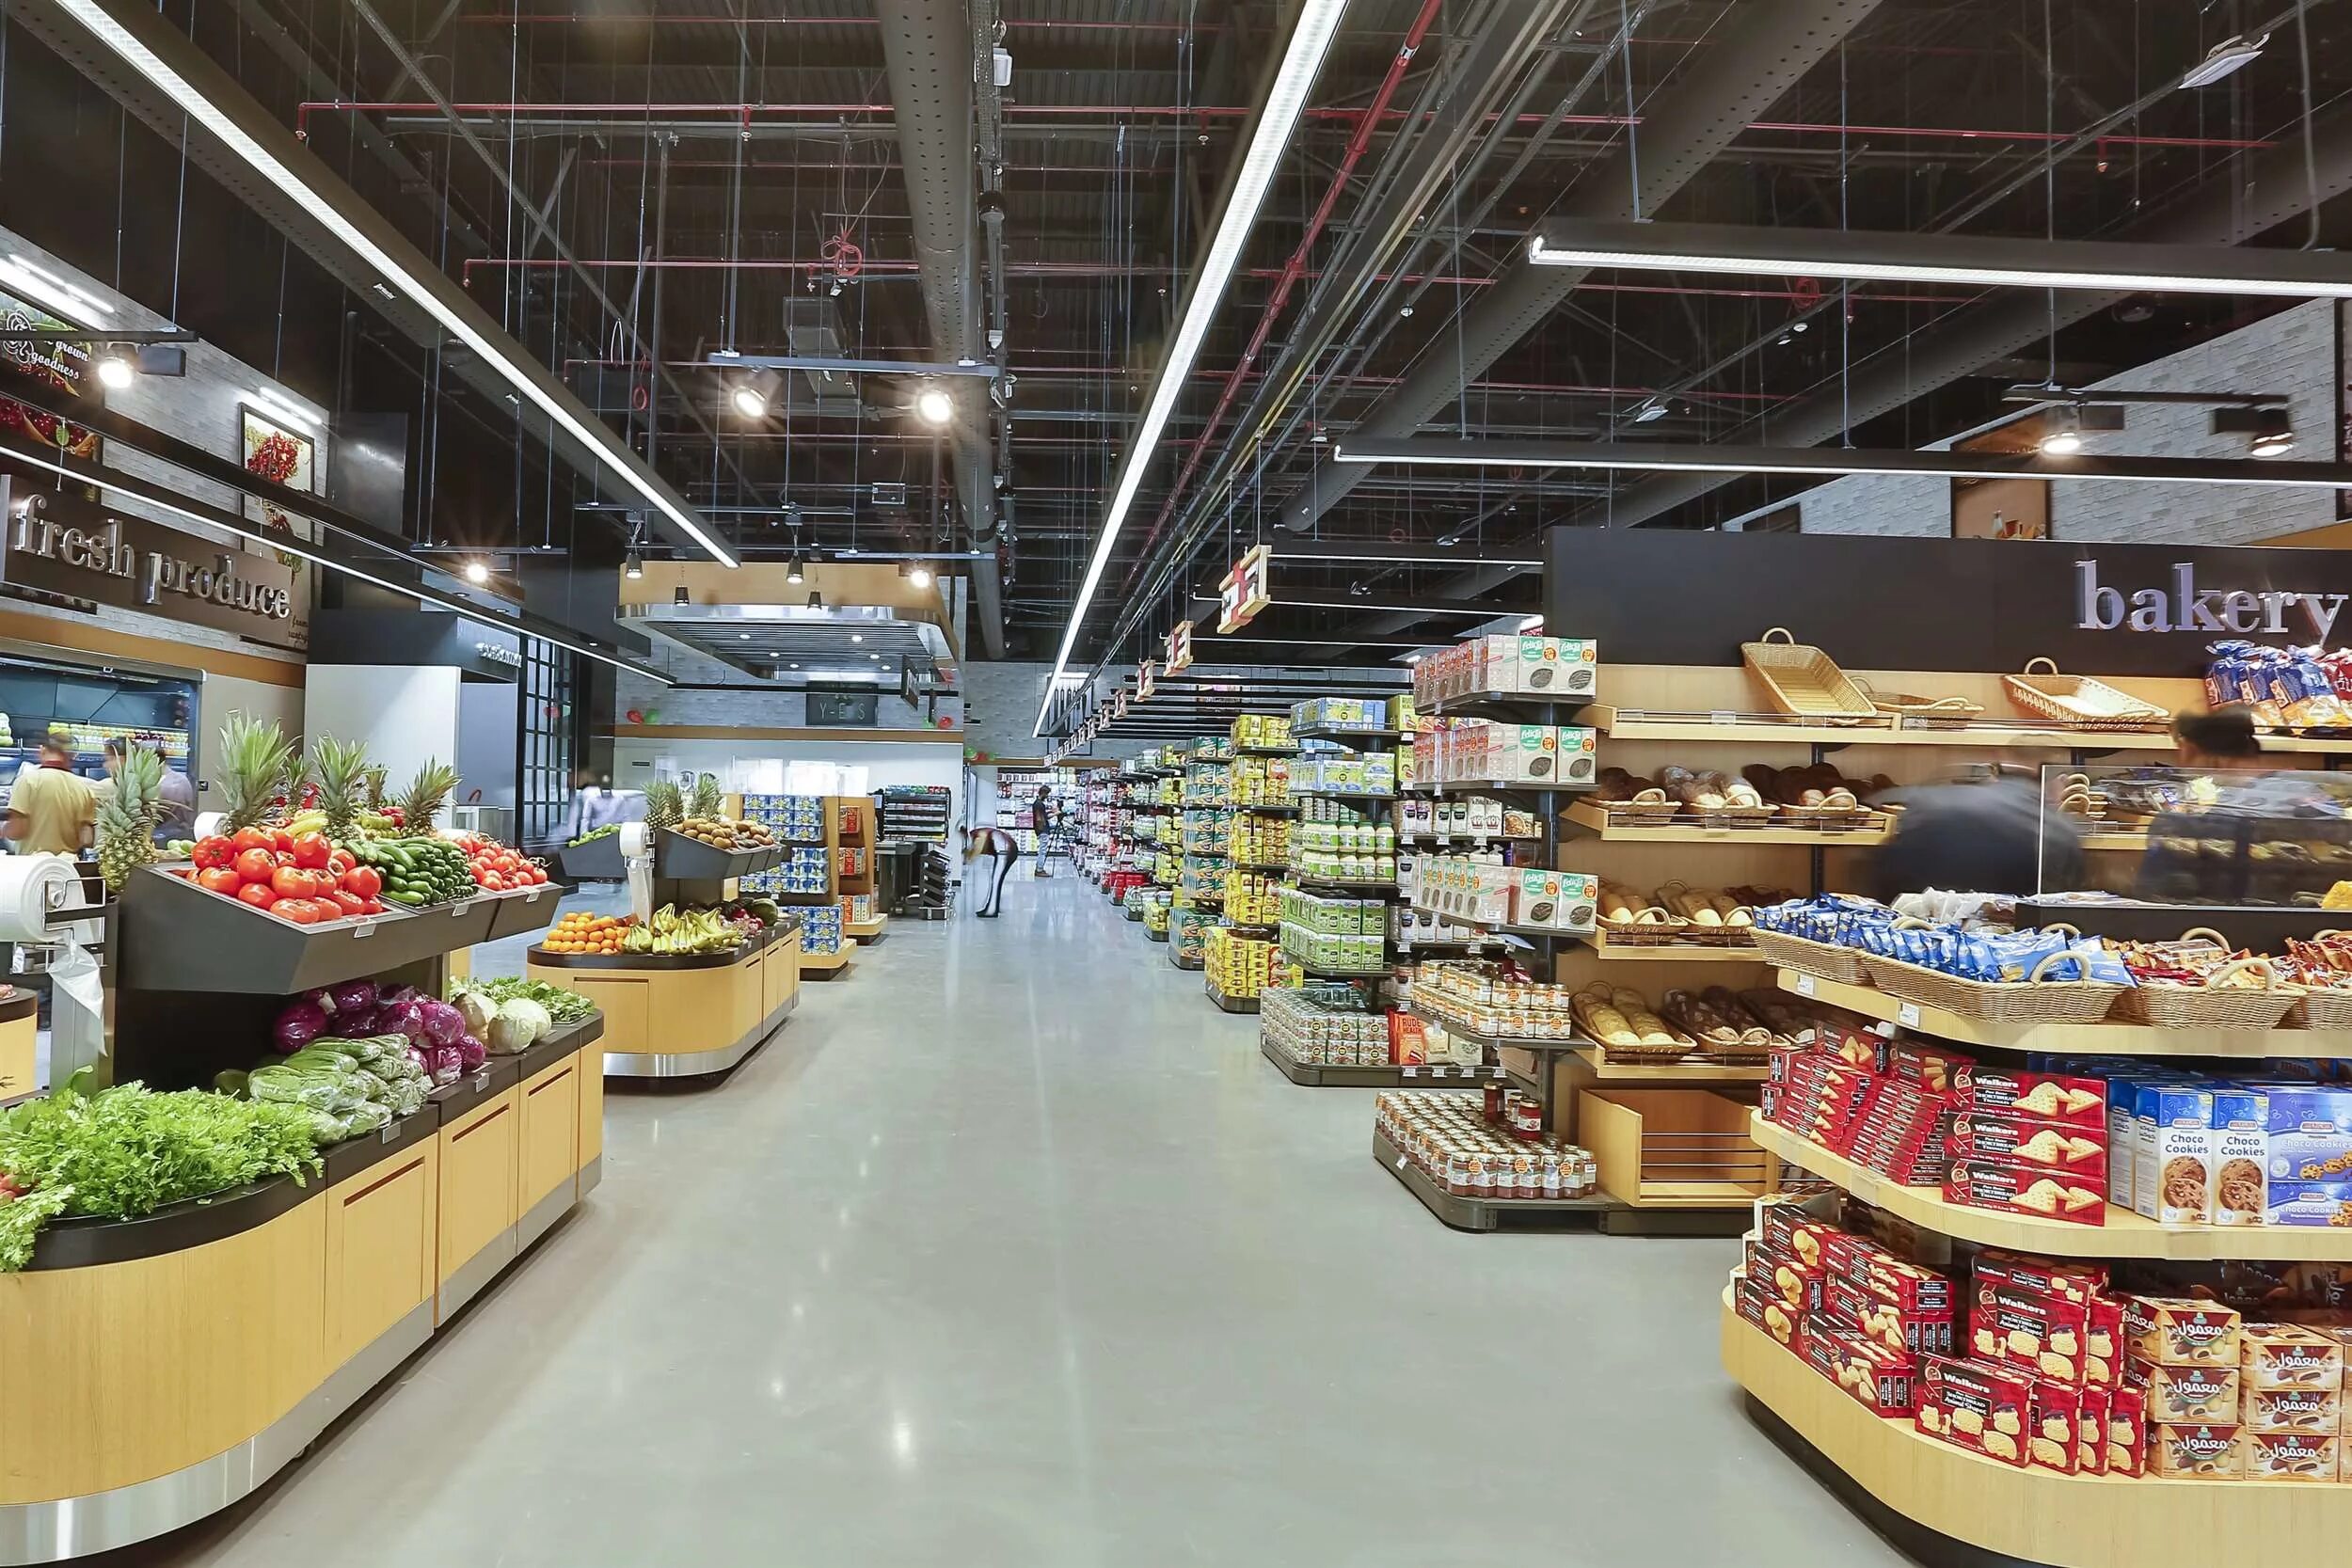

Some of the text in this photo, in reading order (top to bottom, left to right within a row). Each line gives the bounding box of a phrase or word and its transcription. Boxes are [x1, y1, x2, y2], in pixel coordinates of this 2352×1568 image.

[56, 340, 89, 362] grown
[31, 351, 79, 379] goodness
[15, 494, 291, 619] fresh produce
[2075, 560, 2349, 649] bakery
[2170, 1134, 2204, 1144] Choco
[2226, 1136, 2261, 1146] Choco
[2281, 1139, 2312, 1148] Choco
[2165, 1144, 2209, 1154] Cookies
[2220, 1147, 2265, 1156] Cookies
[1998, 1296, 2047, 1316] Walkers
[2177, 1321, 2223, 1338] معمول
[1943, 1372, 1991, 1393] Walkers
[2173, 1378, 2220, 1394] معمول
[2272, 1396, 2319, 1412] معمول
[2181, 1434, 2229, 1451] معمول
[2269, 1441, 2317, 1457] معمول
